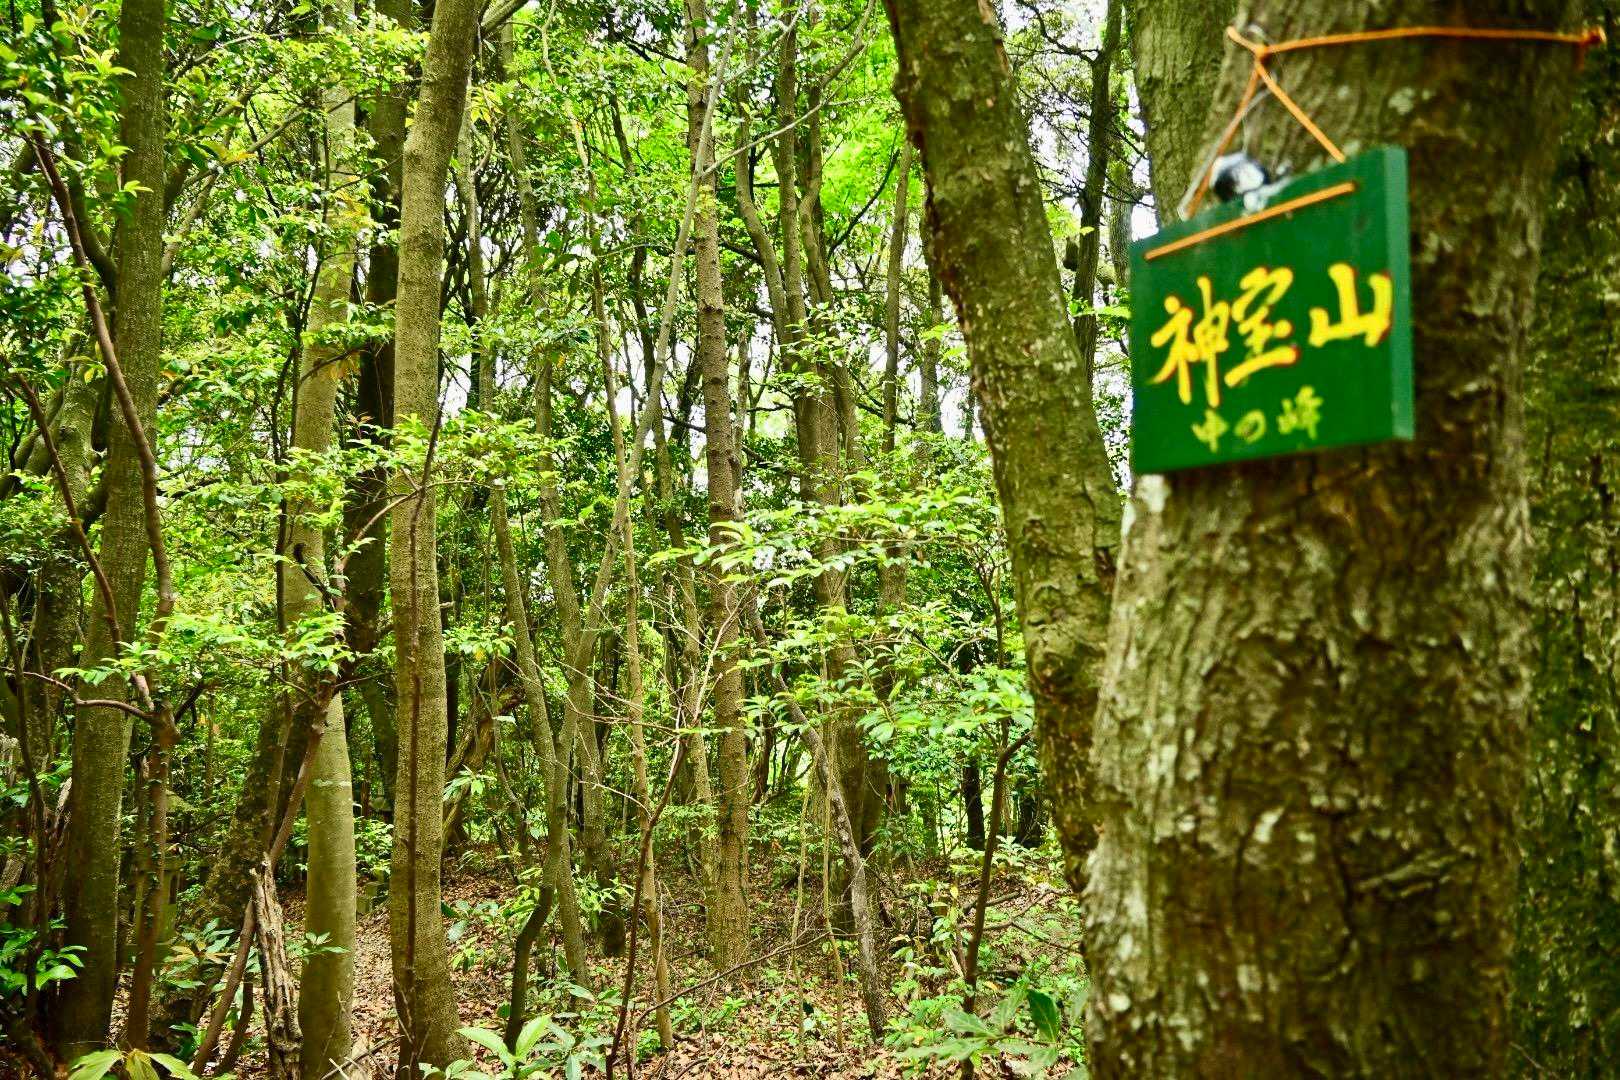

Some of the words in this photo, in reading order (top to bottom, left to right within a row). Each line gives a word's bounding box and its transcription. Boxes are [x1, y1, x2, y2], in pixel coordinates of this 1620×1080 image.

[1151, 263, 1392, 408] 神室山
[1191, 385, 1323, 452] 中の峰
